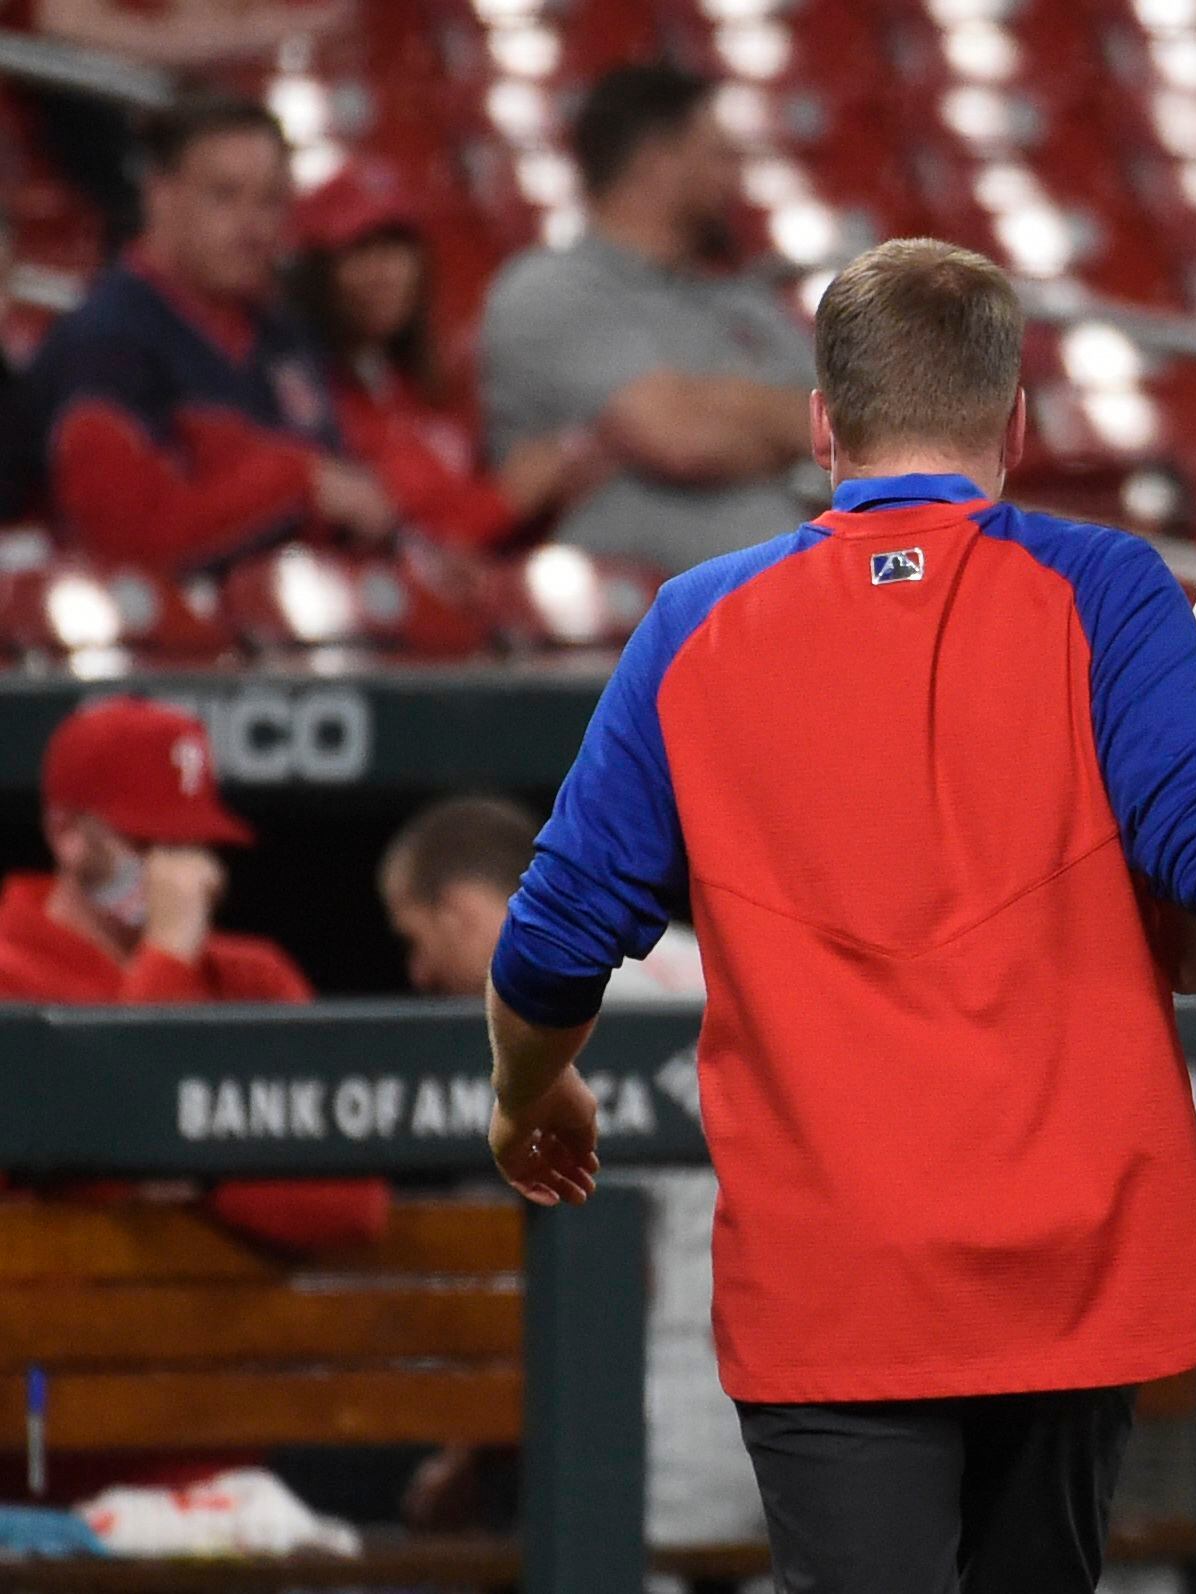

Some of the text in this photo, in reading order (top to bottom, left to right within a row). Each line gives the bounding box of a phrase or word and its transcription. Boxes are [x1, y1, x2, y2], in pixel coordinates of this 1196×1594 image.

[202, 688, 373, 783] ICO
[177, 1076, 655, 1140] BANK OF AMCA
